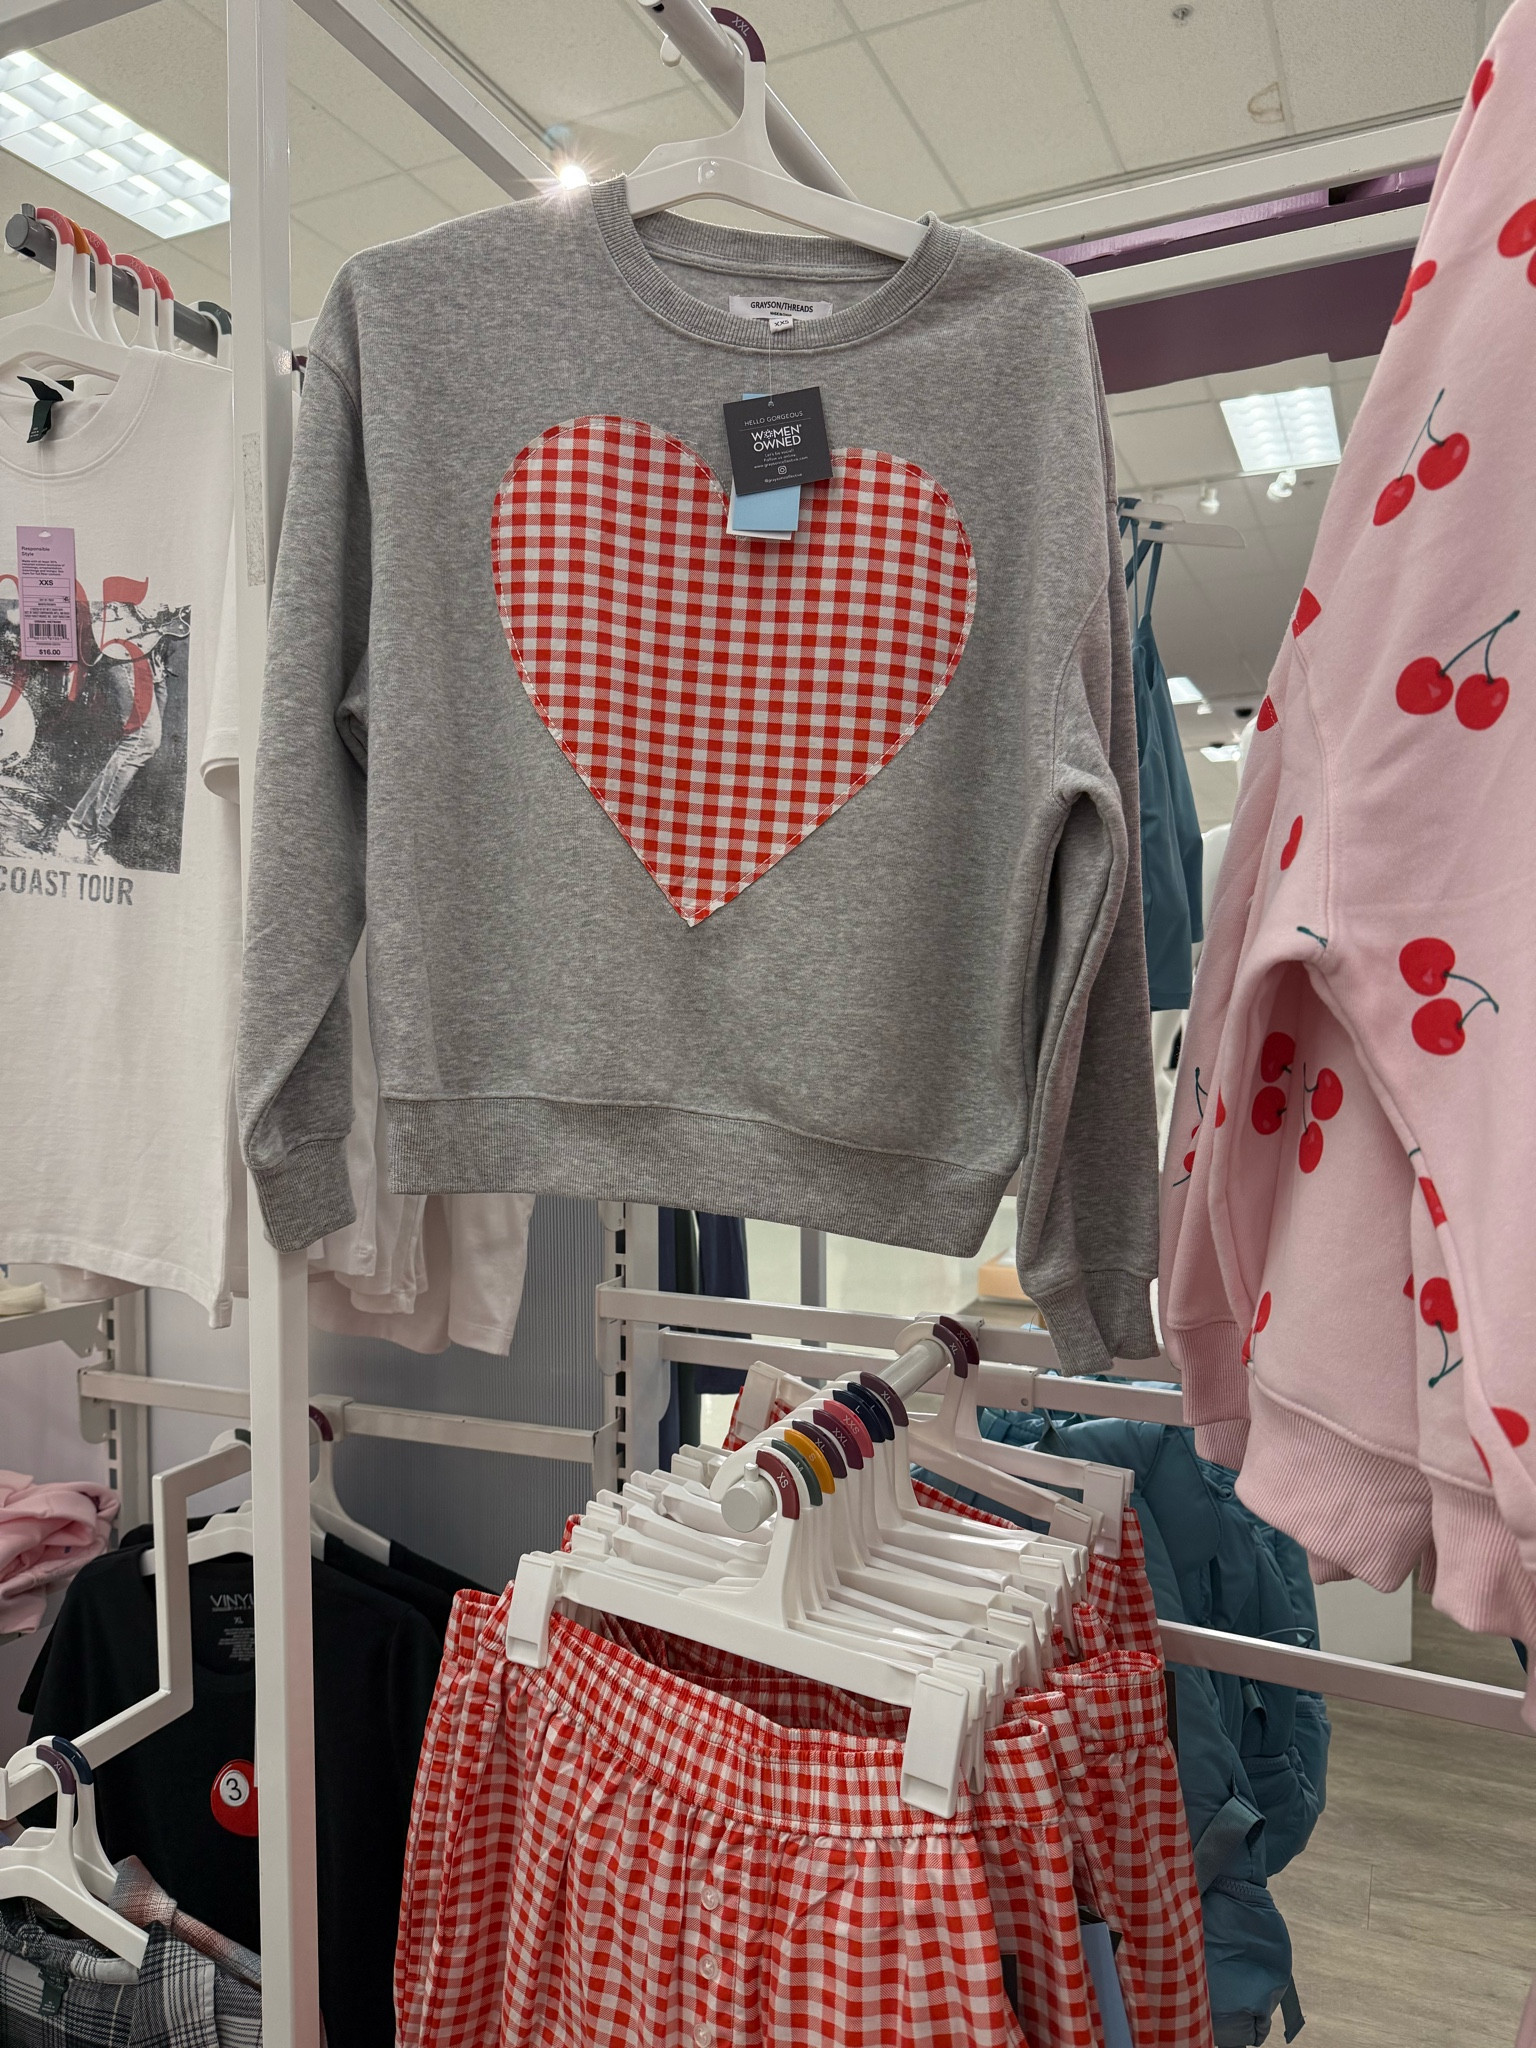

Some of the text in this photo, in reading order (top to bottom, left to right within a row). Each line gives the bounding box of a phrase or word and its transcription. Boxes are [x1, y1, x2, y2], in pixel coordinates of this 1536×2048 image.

[731, 16, 750, 37] XXL
[750, 301, 814, 313] GRAYSON/THREADS
[744, 411, 804, 427] HELLO GORGEOUS
[753, 435, 802, 452] OWNED
[77, 872, 134, 906] TOUR
[956, 1330, 970, 1348] XXL
[949, 1342, 958, 1356] XL
[881, 1390, 891, 1404] XL
[855, 1405, 861, 1414] L
[842, 1414, 860, 1435] XXS
[814, 1437, 827, 1453] XL
[832, 1426, 849, 1448] XXL
[808, 1452, 817, 1462] S
[776, 1471, 789, 1489] XS
[53, 1761, 63, 1774] XL
[226, 1777, 242, 1802] 3
